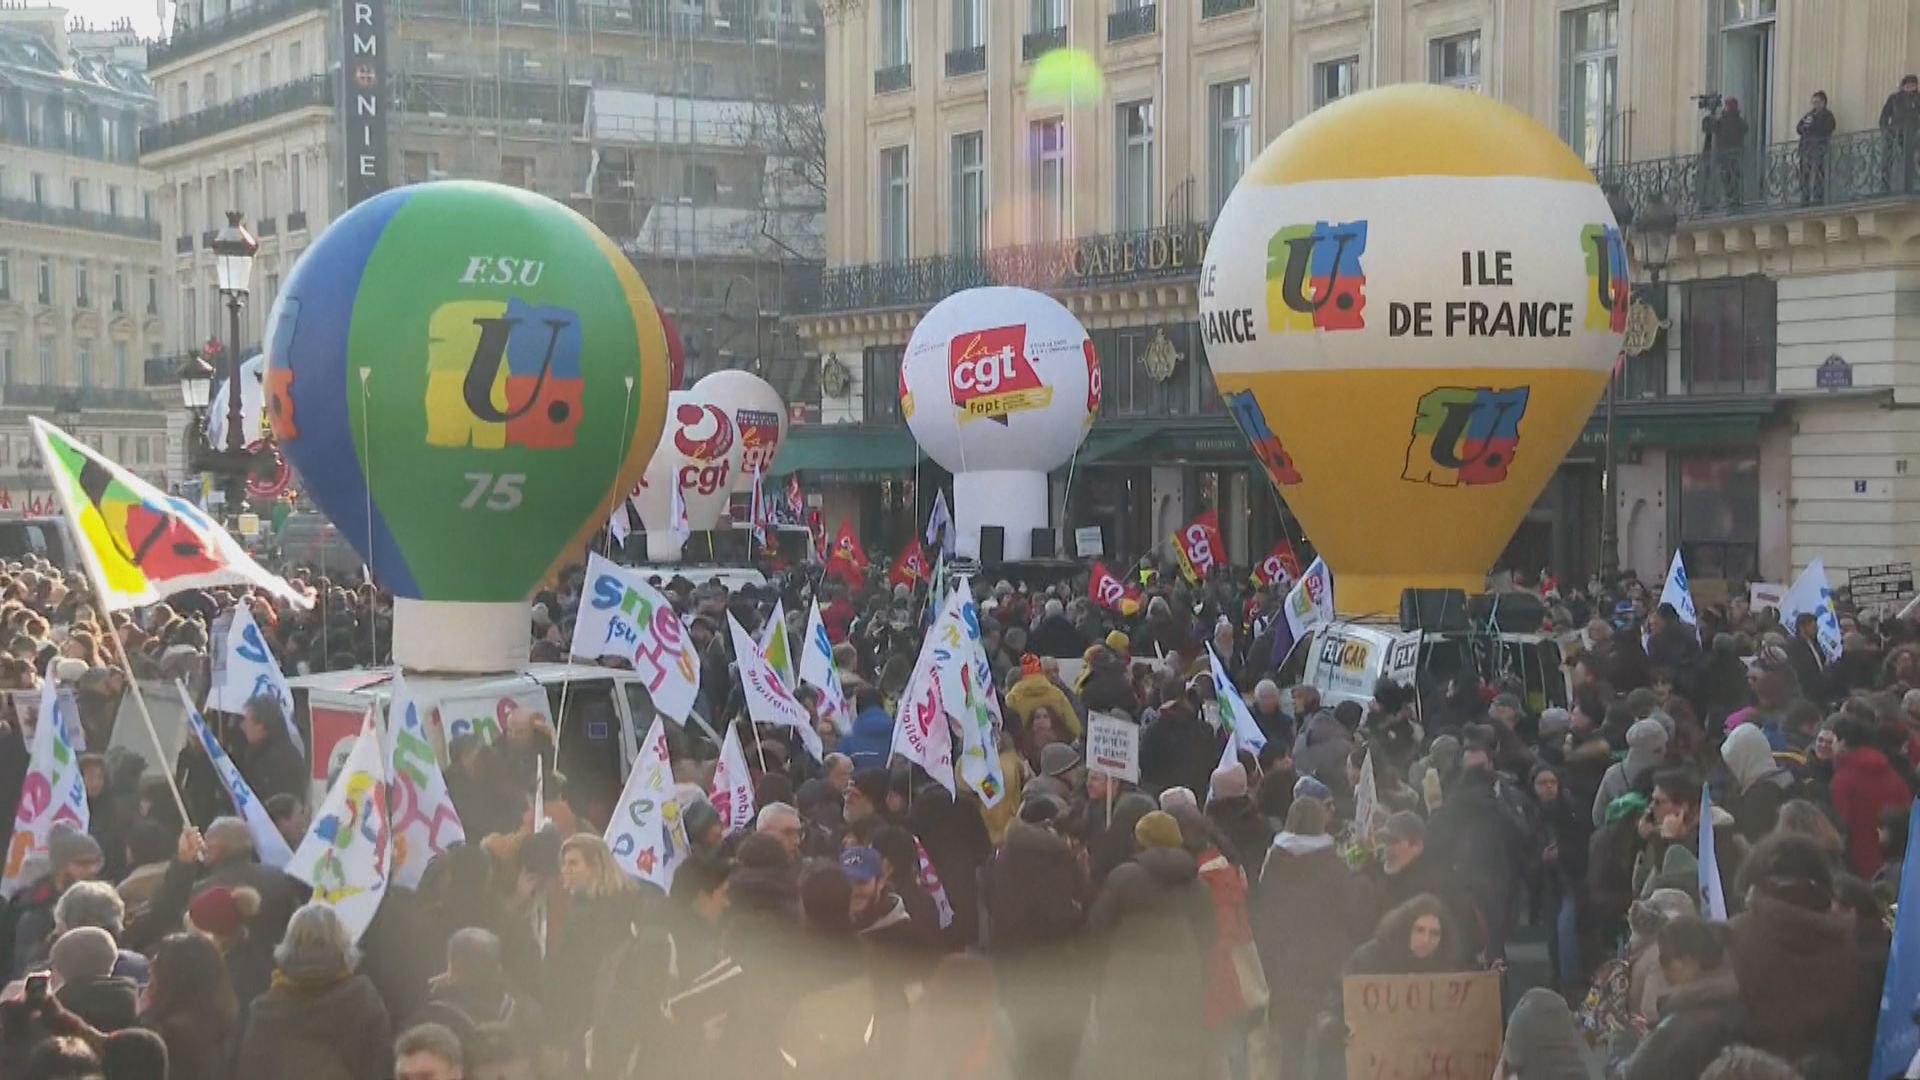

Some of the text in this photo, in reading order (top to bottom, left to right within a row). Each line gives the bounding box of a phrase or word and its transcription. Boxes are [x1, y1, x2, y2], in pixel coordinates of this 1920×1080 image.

[1461, 251, 1513, 286] ILE
[1389, 301, 1573, 338] DE FRANCE
[953, 344, 1017, 393] cgt
[460, 472, 527, 510] 75
[679, 457, 730, 495] cgt
